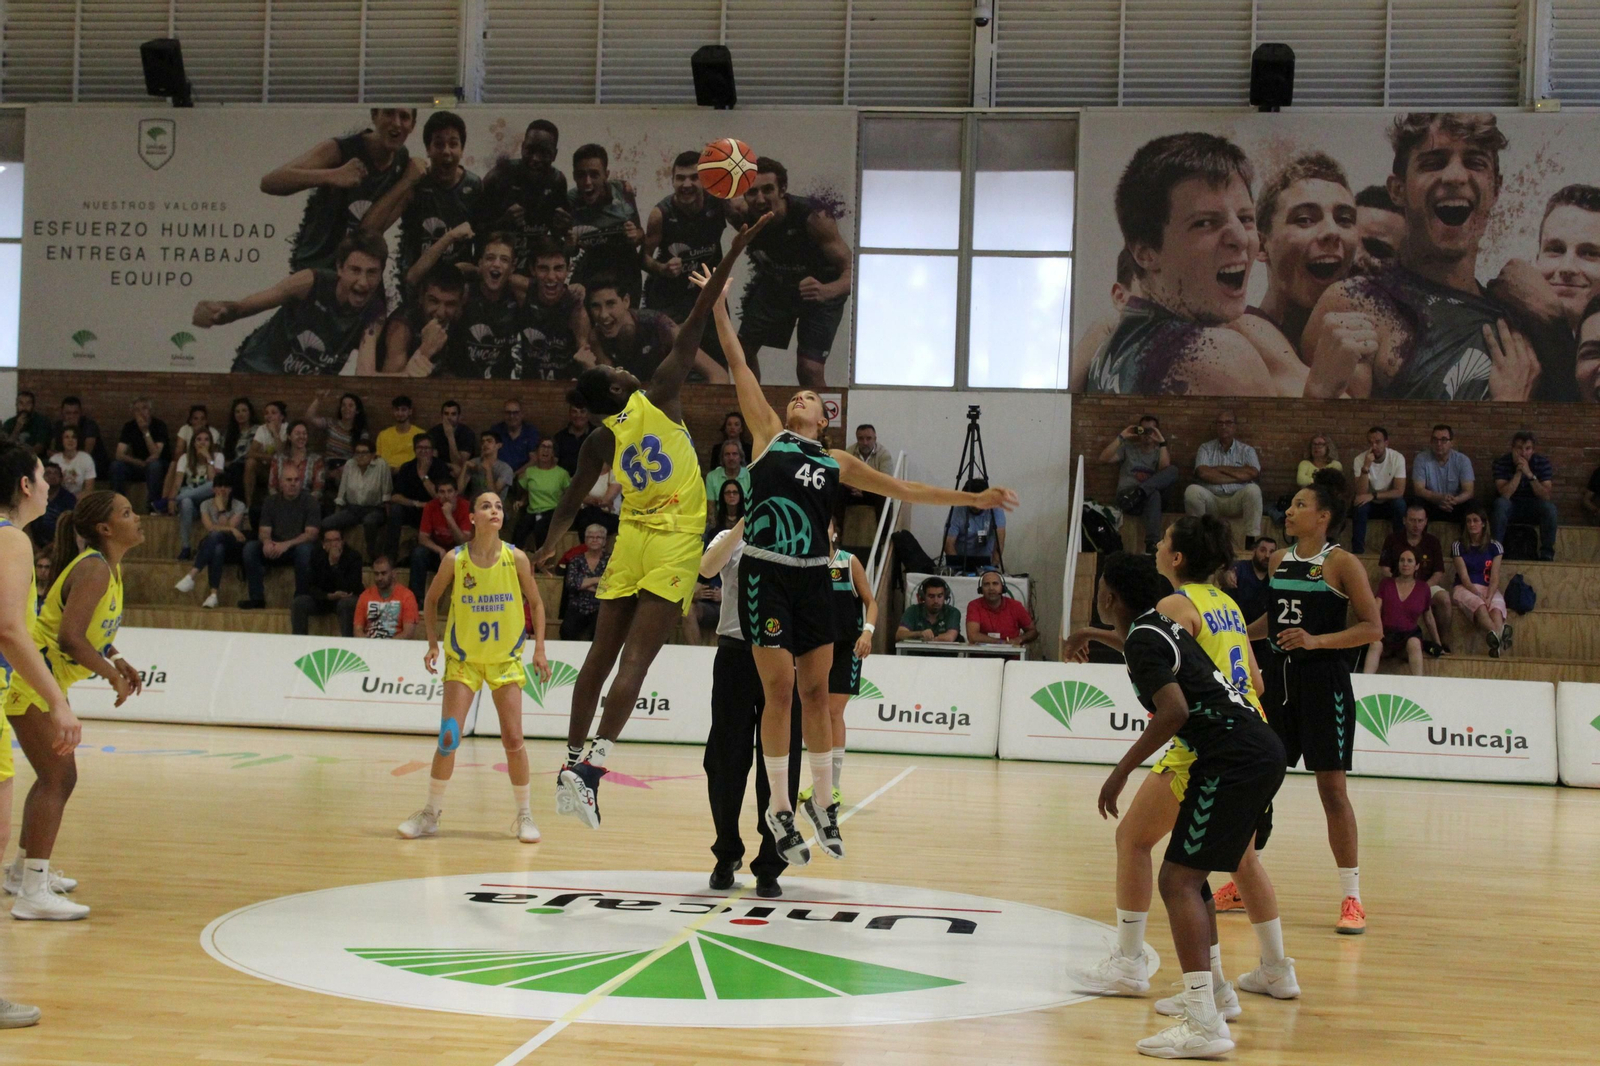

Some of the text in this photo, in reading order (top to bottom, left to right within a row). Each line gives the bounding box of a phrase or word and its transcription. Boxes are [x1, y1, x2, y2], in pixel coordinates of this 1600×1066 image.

[83, 201, 227, 211] NUESTROS VALORES
[33, 221, 276, 238] ESFUERZO HUMILDAD
[47, 246, 260, 262] ENTREGA TRABAJO
[111, 271, 193, 286] EQUIPO
[620, 433, 673, 491] 63
[794, 462, 826, 490] 46
[472, 604, 504, 612] TENERIFE
[478, 593, 513, 603] ADAREVA
[1277, 598, 1303, 624] 25
[479, 621, 499, 642] 91
[1229, 645, 1250, 694] 6
[878, 703, 971, 731] Unicaja
[1427, 726, 1529, 754] Unicaja
[464, 892, 978, 935] Unicaja
